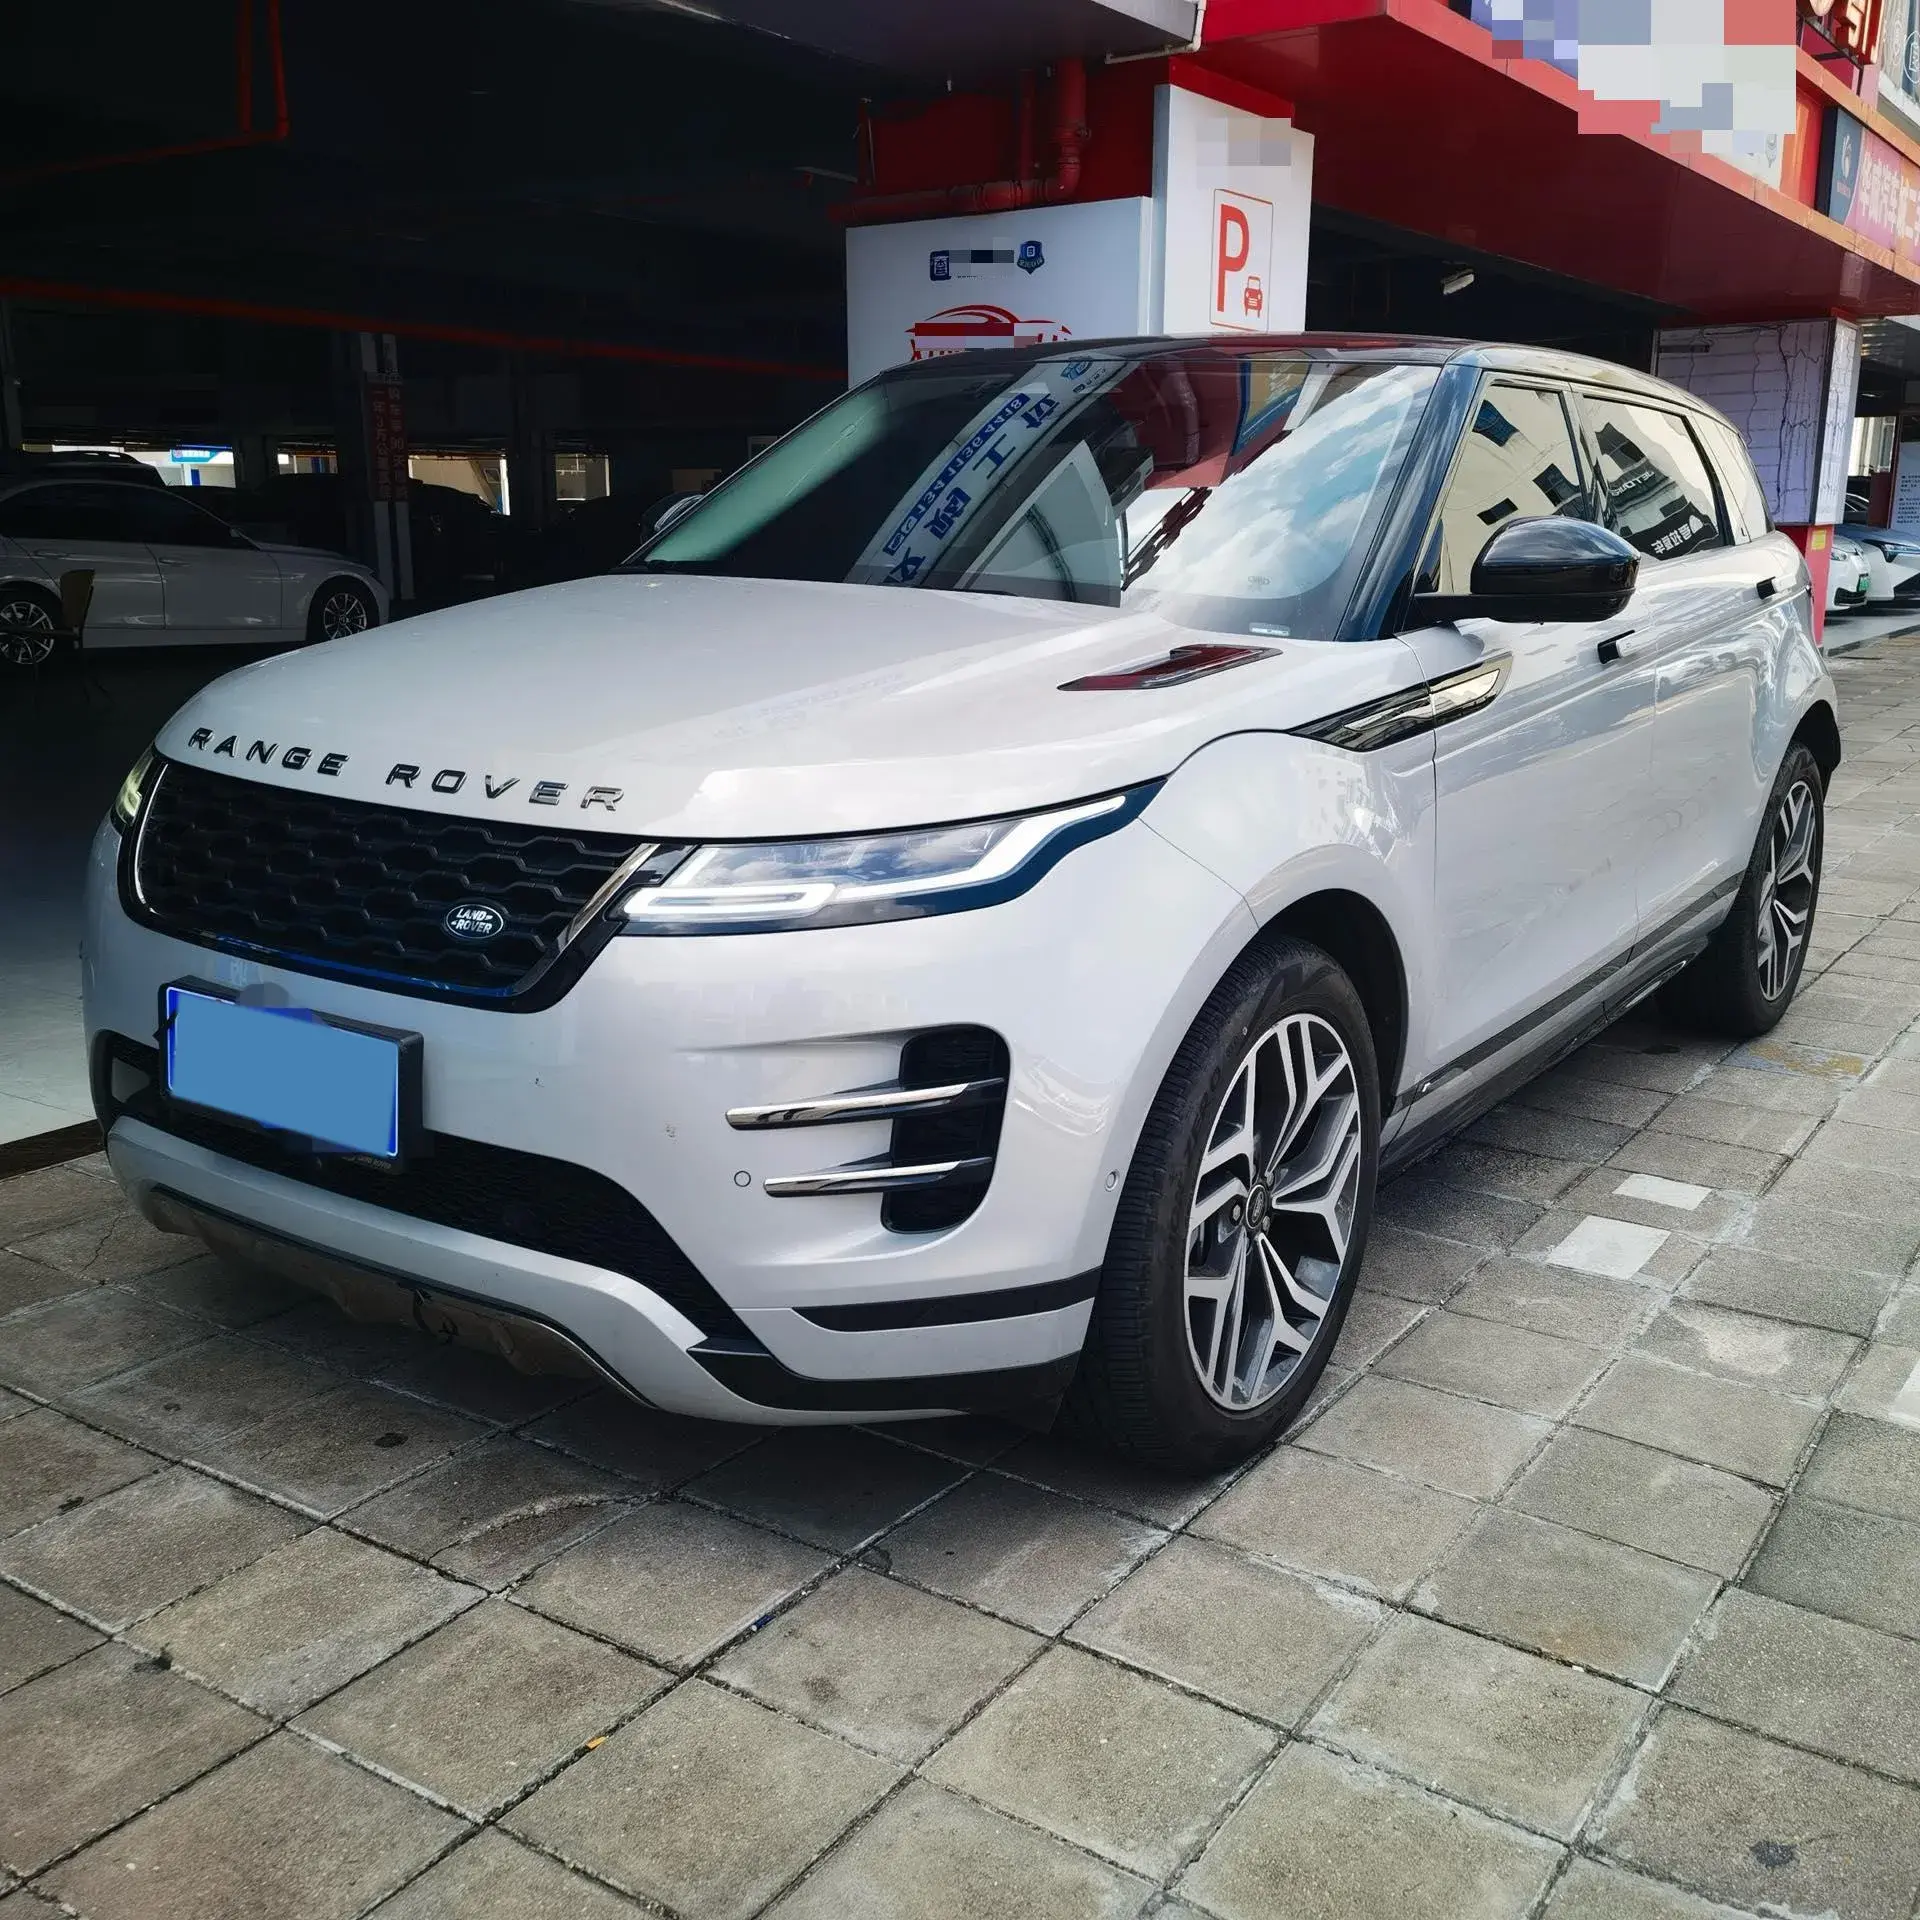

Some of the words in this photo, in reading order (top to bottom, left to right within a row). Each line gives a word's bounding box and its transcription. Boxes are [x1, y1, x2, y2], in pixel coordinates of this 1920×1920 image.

[1218, 203, 1250, 312] P
[188, 727, 349, 777] RANGE
[385, 763, 625, 812] ROVER
[456, 908, 487, 921] LAND
[456, 919, 493, 933] ROVER
